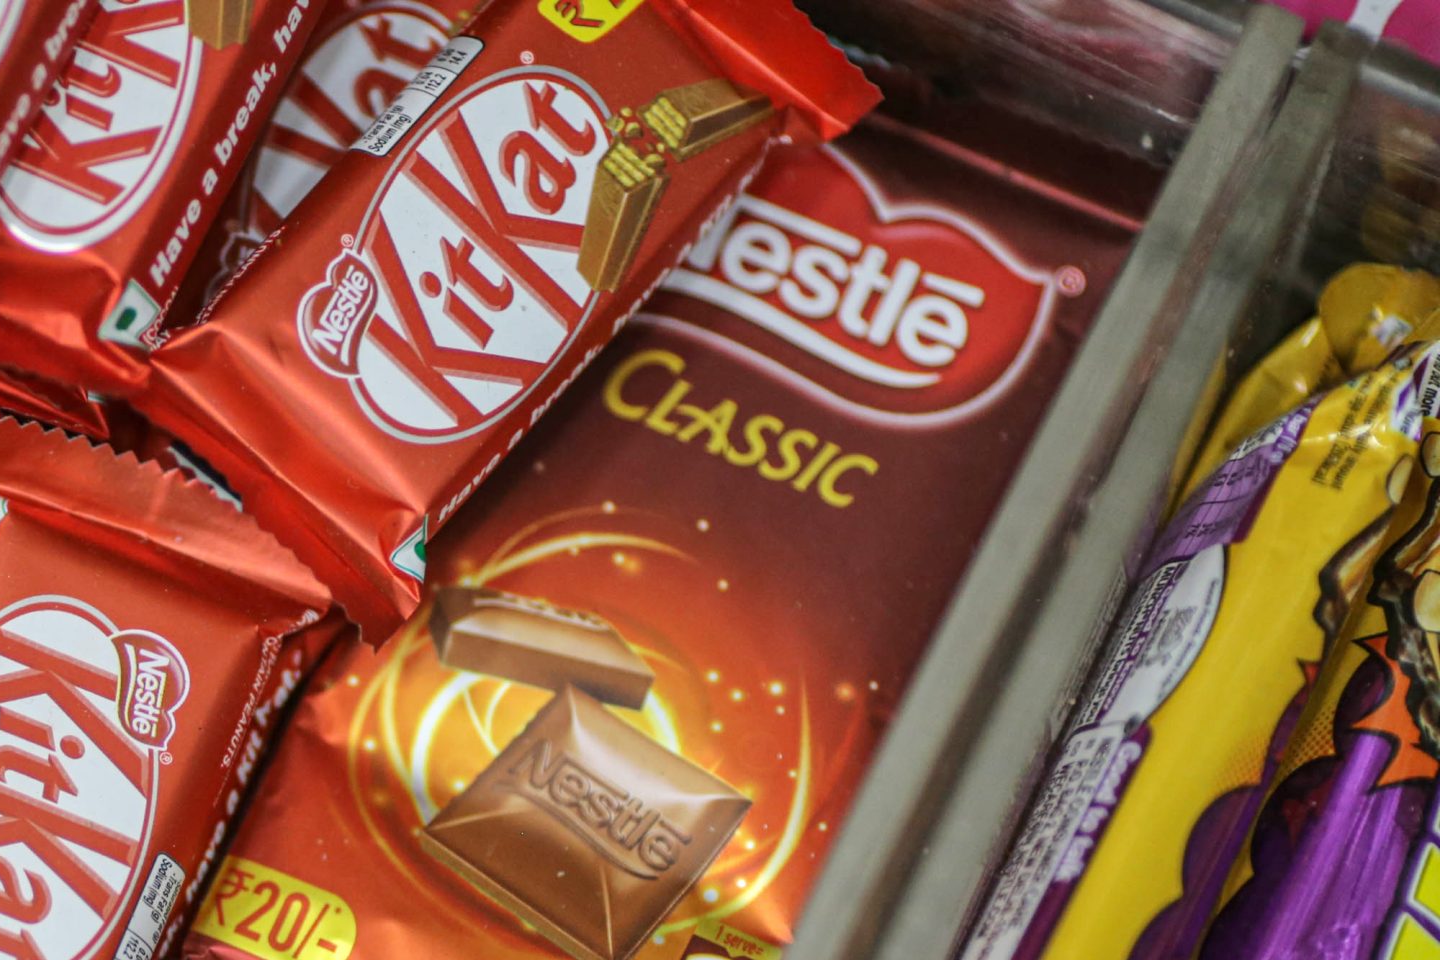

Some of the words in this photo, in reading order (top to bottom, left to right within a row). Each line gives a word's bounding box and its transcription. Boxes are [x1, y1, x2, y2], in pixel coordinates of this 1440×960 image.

[206, 56, 282, 166] break,
[367, 123, 396, 156] Sodium
[391, 110, 413, 132] (mg)
[423, 69, 447, 95] 112.2
[447, 46, 468, 67] 14.4
[196, 165, 223, 196] a
[141, 194, 208, 288] Have
[362, 79, 609, 428] KitKat
[312, 264, 372, 361] Nestlé
[603, 349, 879, 510] CLASSIC
[130, 644, 173, 741] Nestlé
[139, 885, 160, 909] (mg)
[147, 908, 163, 924] (g)
[149, 857, 175, 891] Sodium
[153, 896, 168, 913] Fat
[121, 936, 140, 959] 112.2
